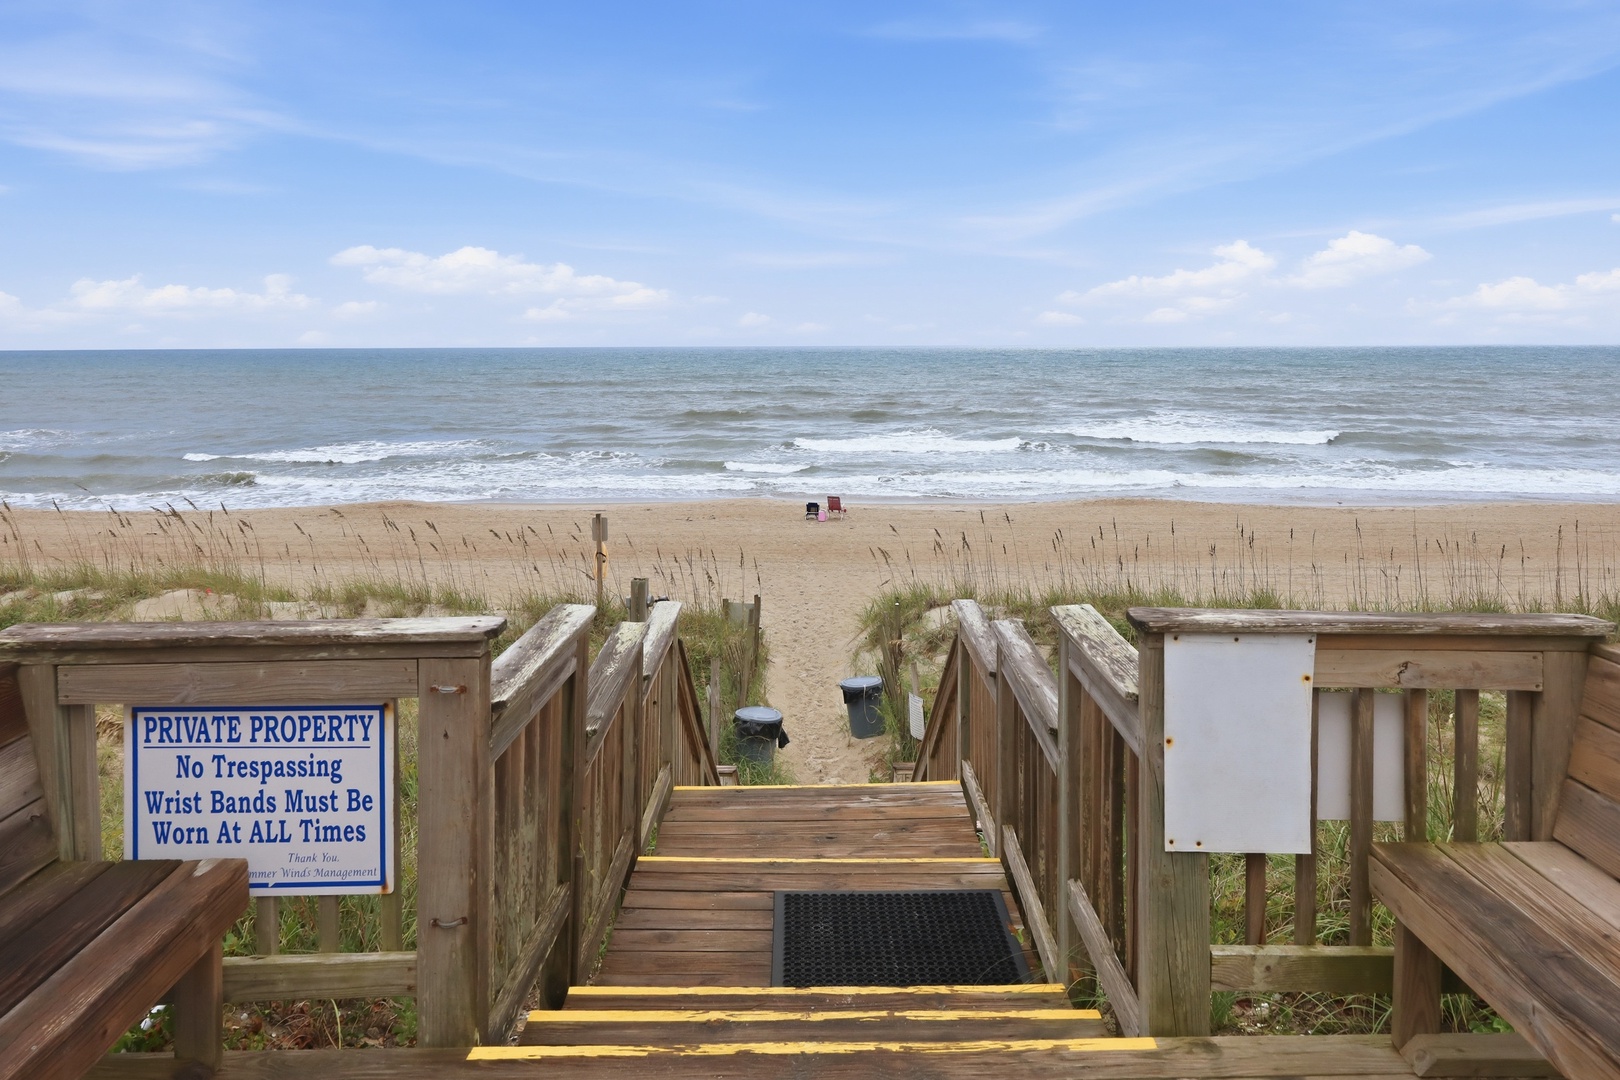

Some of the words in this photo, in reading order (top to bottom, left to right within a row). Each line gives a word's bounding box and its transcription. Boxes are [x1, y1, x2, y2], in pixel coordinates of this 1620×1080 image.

[143, 716, 242, 743] PRIVATE
[249, 714, 374, 743] PROPERTY
[175, 754, 204, 779] No
[211, 752, 343, 785] Trespassing
[144, 790, 203, 815] Wrist
[210, 789, 277, 814] Bands
[284, 788, 339, 813] Must
[346, 788, 374, 812] Be
[152, 821, 210, 845] Worn
[216, 820, 242, 844] At
[248, 819, 293, 844] ALL
[299, 818, 367, 844] Times
[288, 852, 318, 863] Thank
[280, 867, 312, 878] Winds
[313, 867, 378, 880] Management
